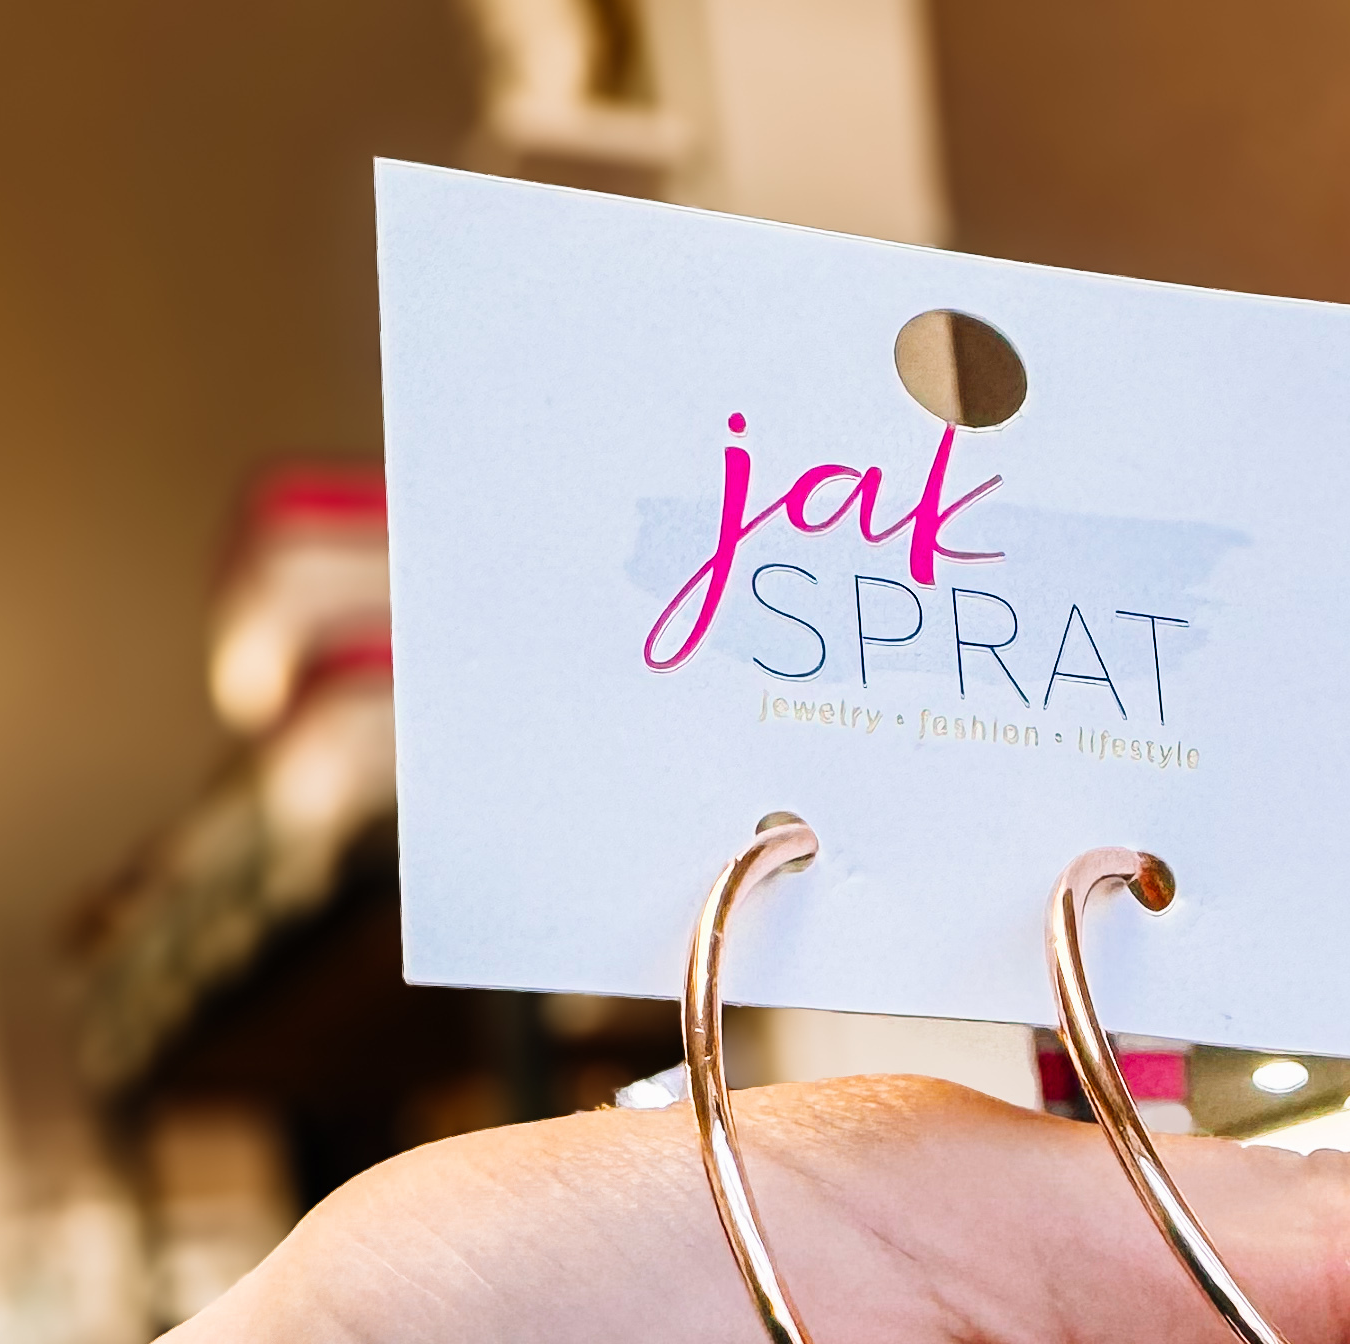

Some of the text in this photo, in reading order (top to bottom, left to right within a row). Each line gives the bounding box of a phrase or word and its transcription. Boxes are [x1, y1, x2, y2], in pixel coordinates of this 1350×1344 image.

[643, 411, 1006, 674] jak
[751, 562, 1190, 726] SPRAT
[757, 688, 1201, 770] jewelry fashion lifestyle
